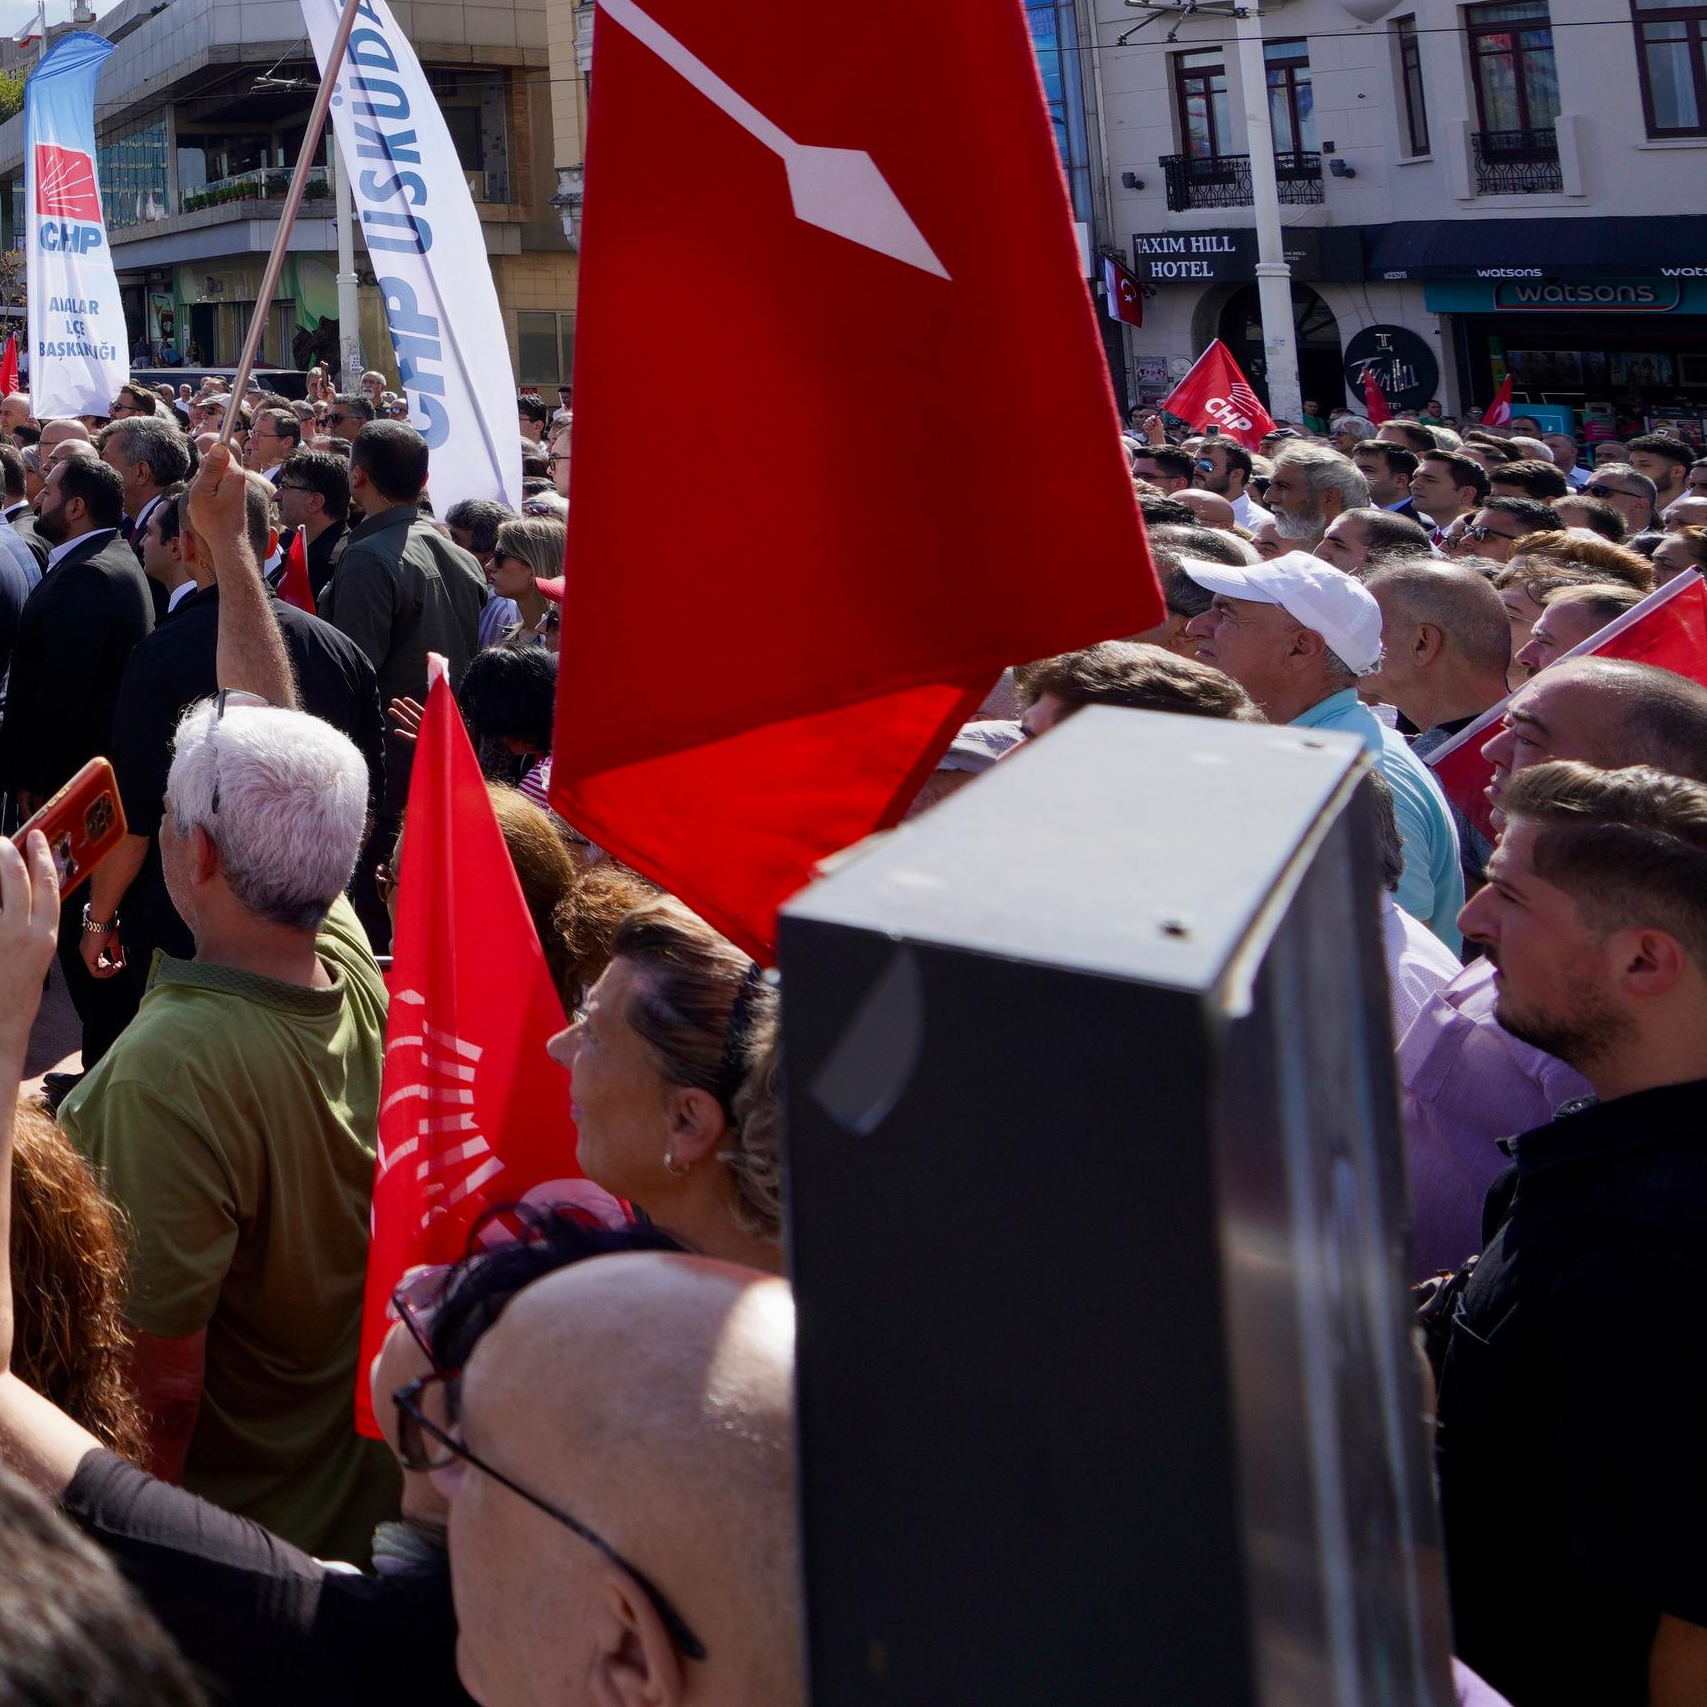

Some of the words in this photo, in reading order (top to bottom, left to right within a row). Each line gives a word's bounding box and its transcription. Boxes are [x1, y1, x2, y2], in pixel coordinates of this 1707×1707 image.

[40, 221, 102, 255] CHP
[1136, 237, 1185, 254] TAXIM
[1189, 236, 1236, 253] HILL
[1151, 261, 1214, 277] HOTEL
[1477, 267, 1543, 277] watsons
[1515, 283, 1655, 302] watsons
[378, 276, 450, 450] CHP
[1204, 397, 1253, 431] CHP
